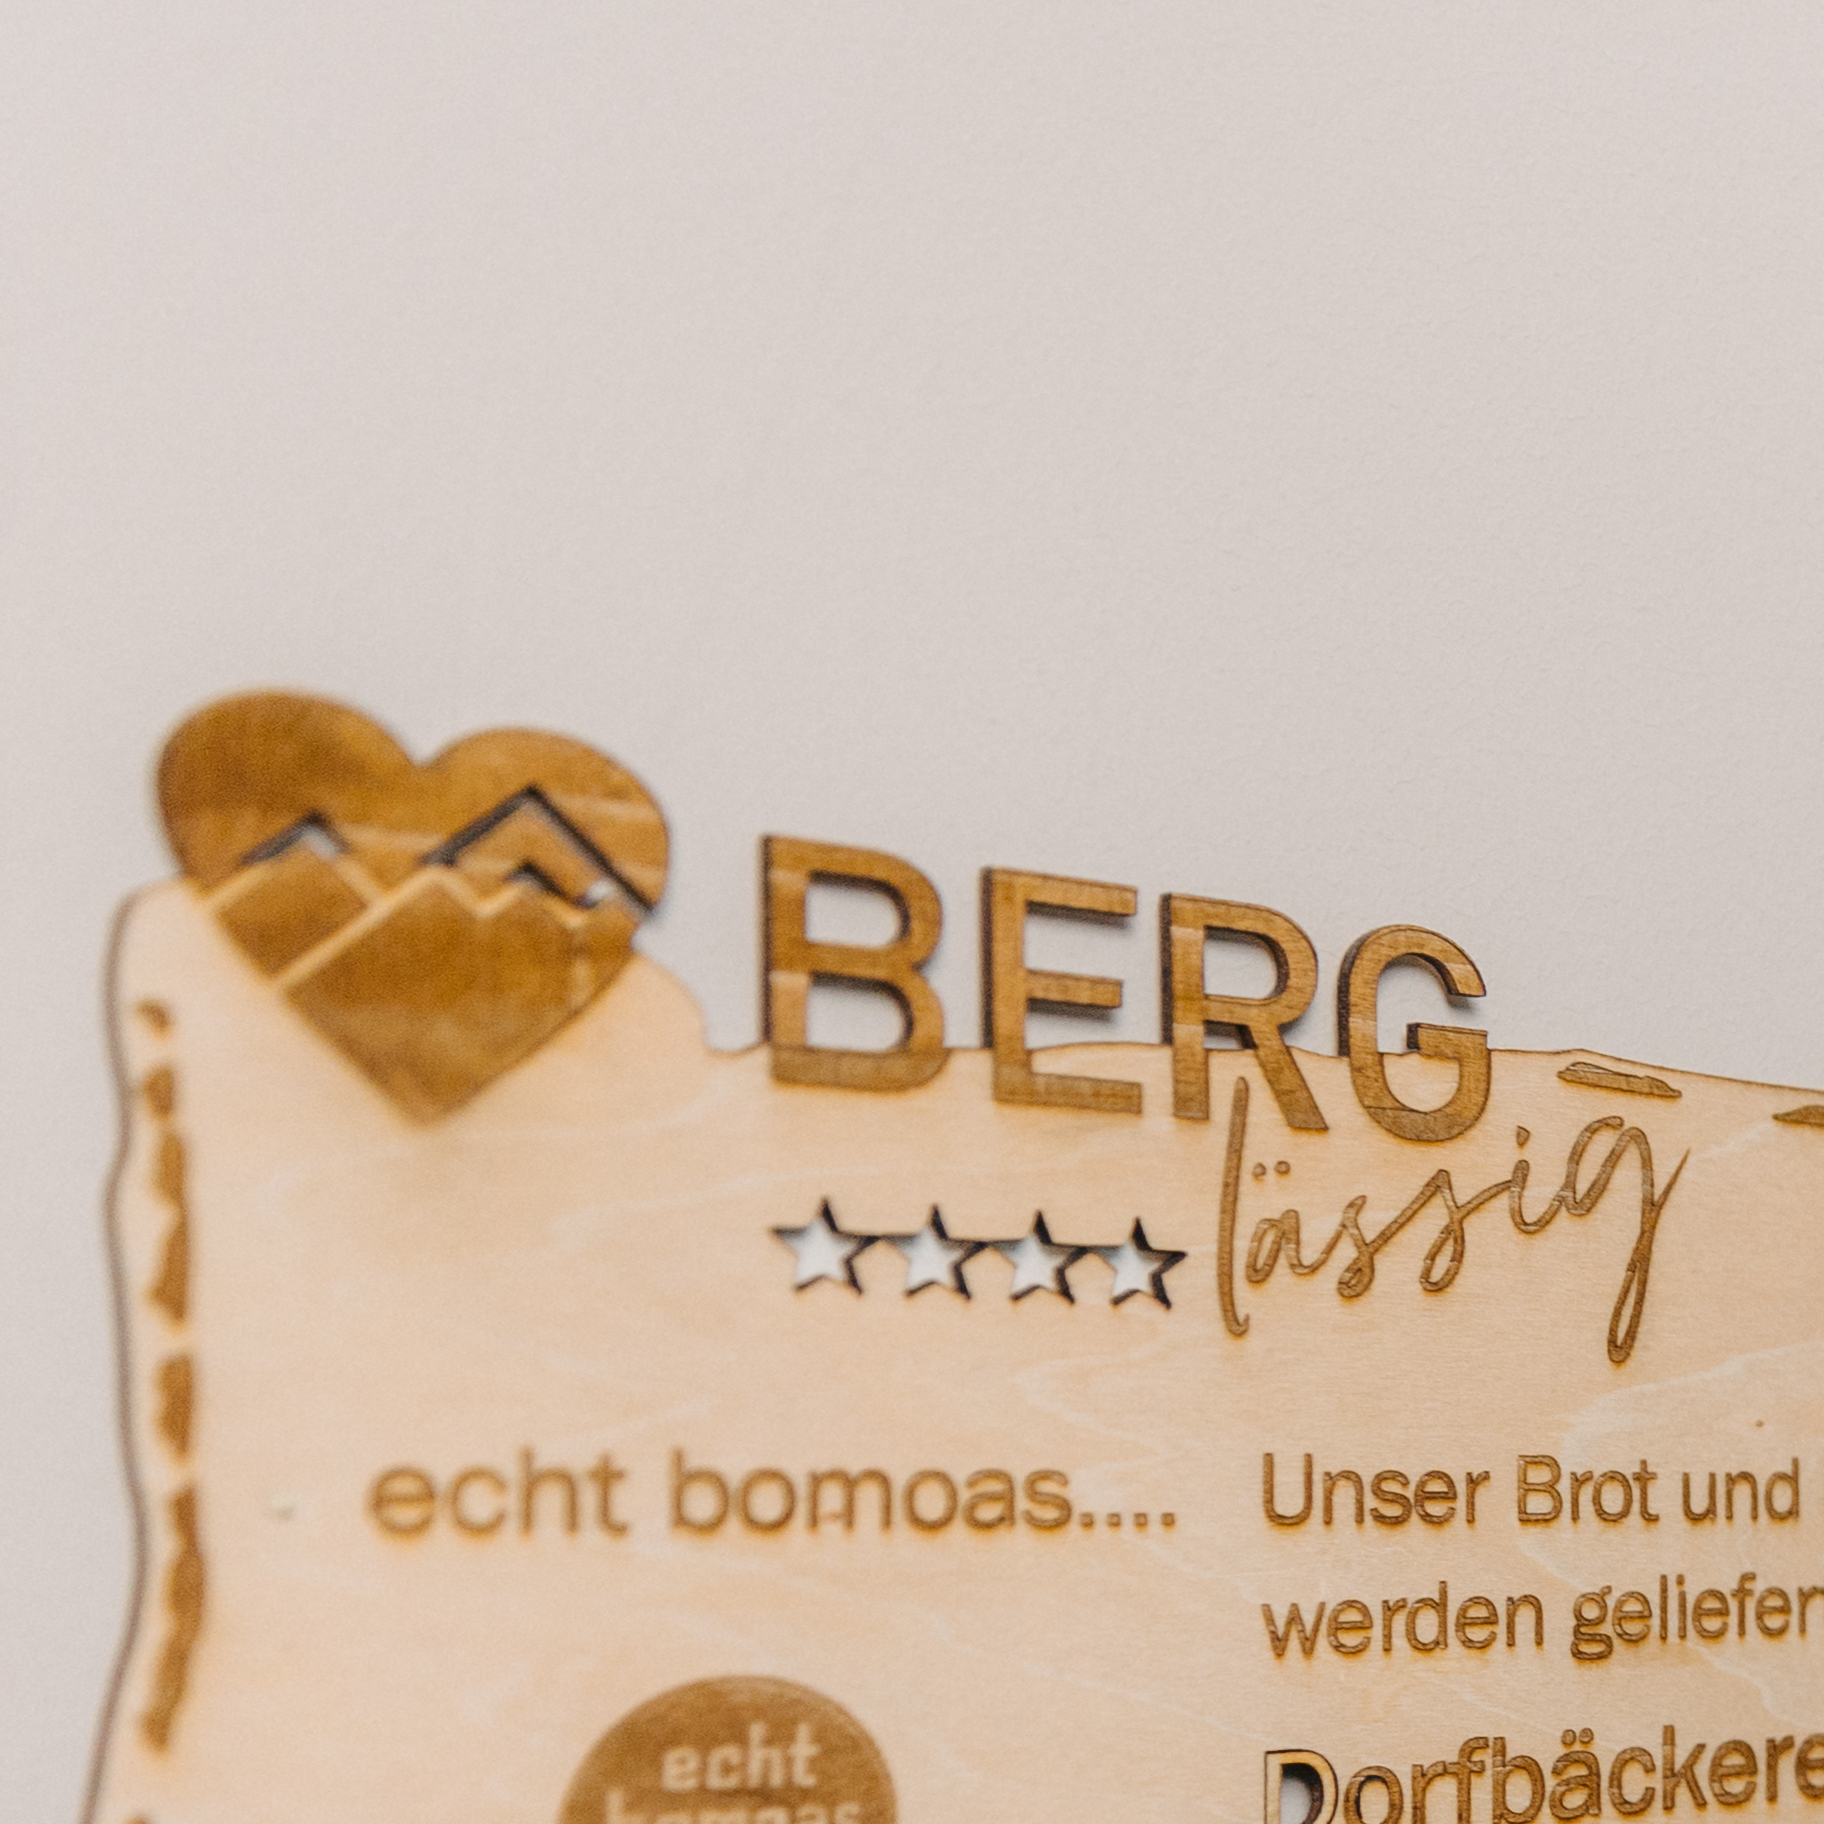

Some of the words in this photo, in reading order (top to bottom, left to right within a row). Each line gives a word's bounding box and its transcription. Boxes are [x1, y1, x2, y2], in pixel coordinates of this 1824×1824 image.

[761, 834, 1493, 1143] BERG
[1216, 1075, 1692, 1365] lässig
[366, 1446, 629, 1538] echt
[669, 1446, 1178, 1534] bomoas....
[1261, 1452, 1490, 1528] Unser
[1516, 1453, 1660, 1524] Brot
[1681, 1458, 1801, 1522] und
[1261, 1580, 1544, 1660] werden
[660, 1721, 821, 1794] echt
